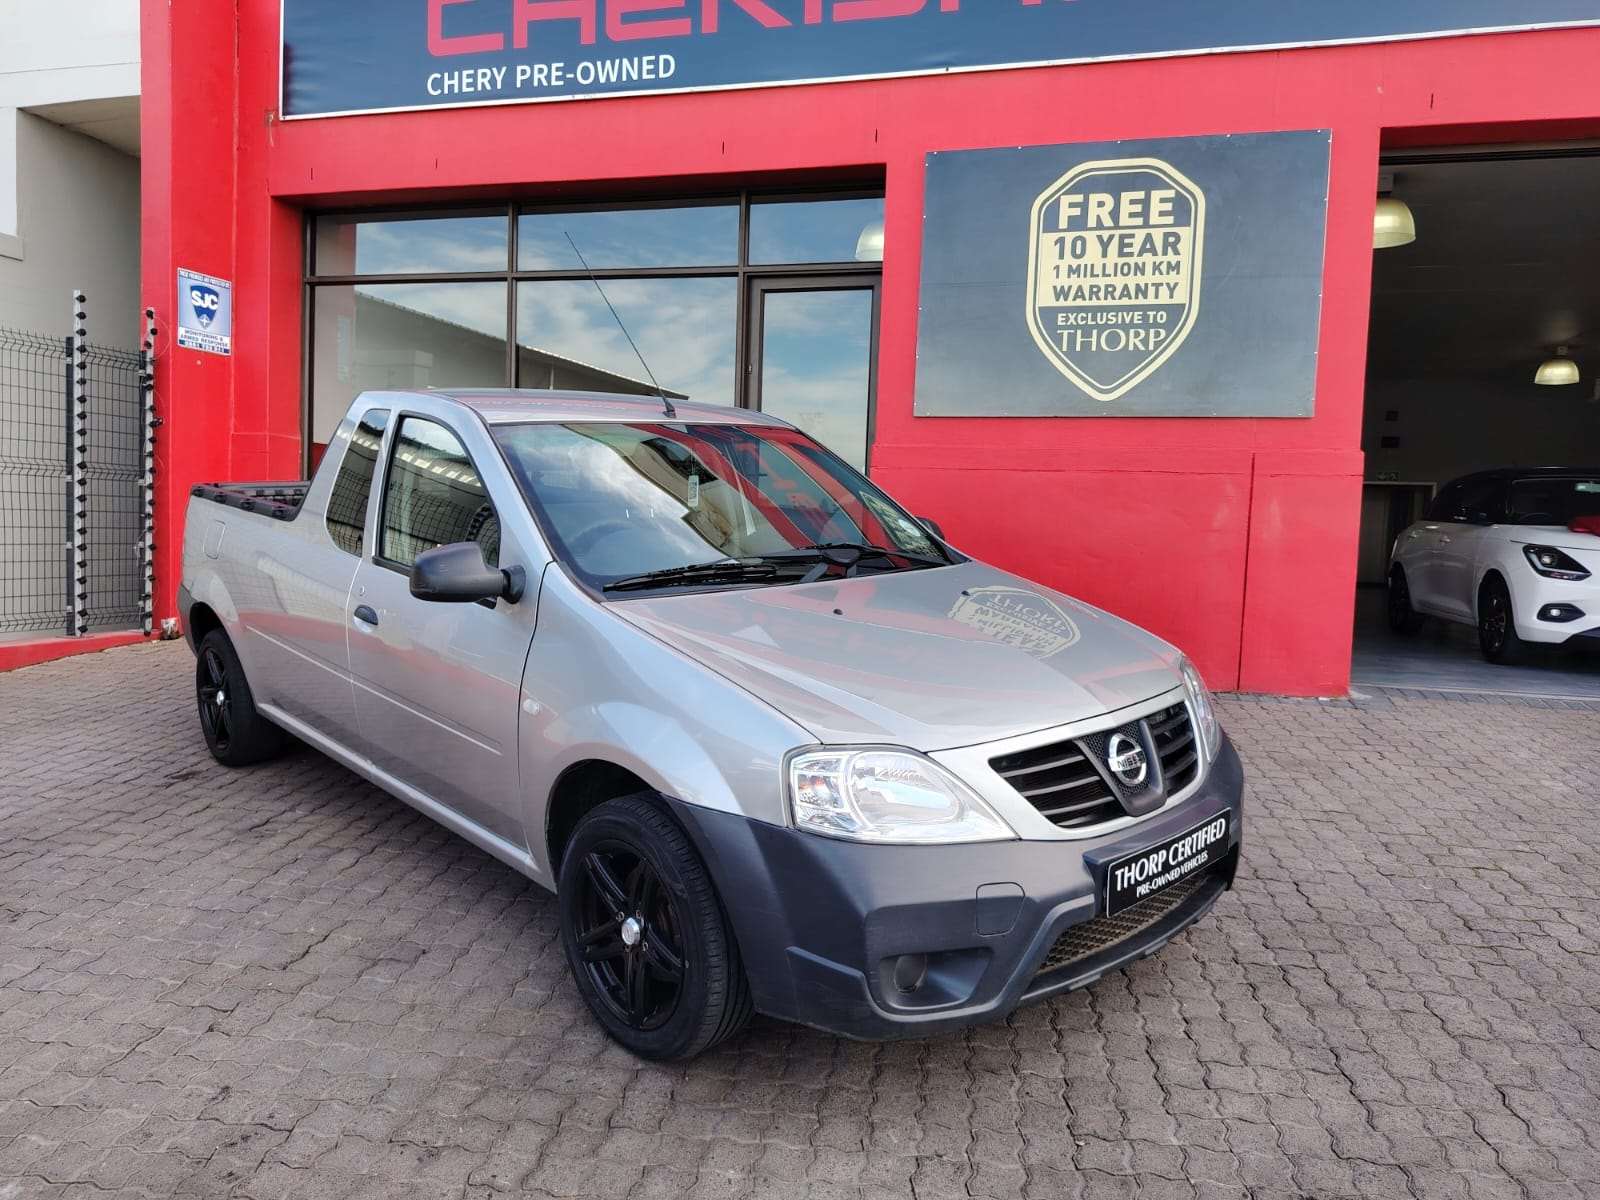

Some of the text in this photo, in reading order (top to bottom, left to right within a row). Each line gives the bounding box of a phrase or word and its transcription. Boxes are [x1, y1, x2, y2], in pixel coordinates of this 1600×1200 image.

[426, 53, 676, 96] CHERY PRE-OWNED
[1058, 189, 1176, 229] FREE
[1053, 231, 1182, 260] 10 YEAR
[1052, 260, 1181, 279] 1 MILLION KM
[191, 290, 219, 310] SJC
[1052, 282, 1180, 302] WARRANTY
[1057, 311, 1167, 326] EXCLUSIVE TO
[1057, 328, 1167, 352] THORP
[1114, 818, 1226, 892] THORP CERTIFIED
[1136, 850, 1209, 898] PRE-OWNED VEHICLES
